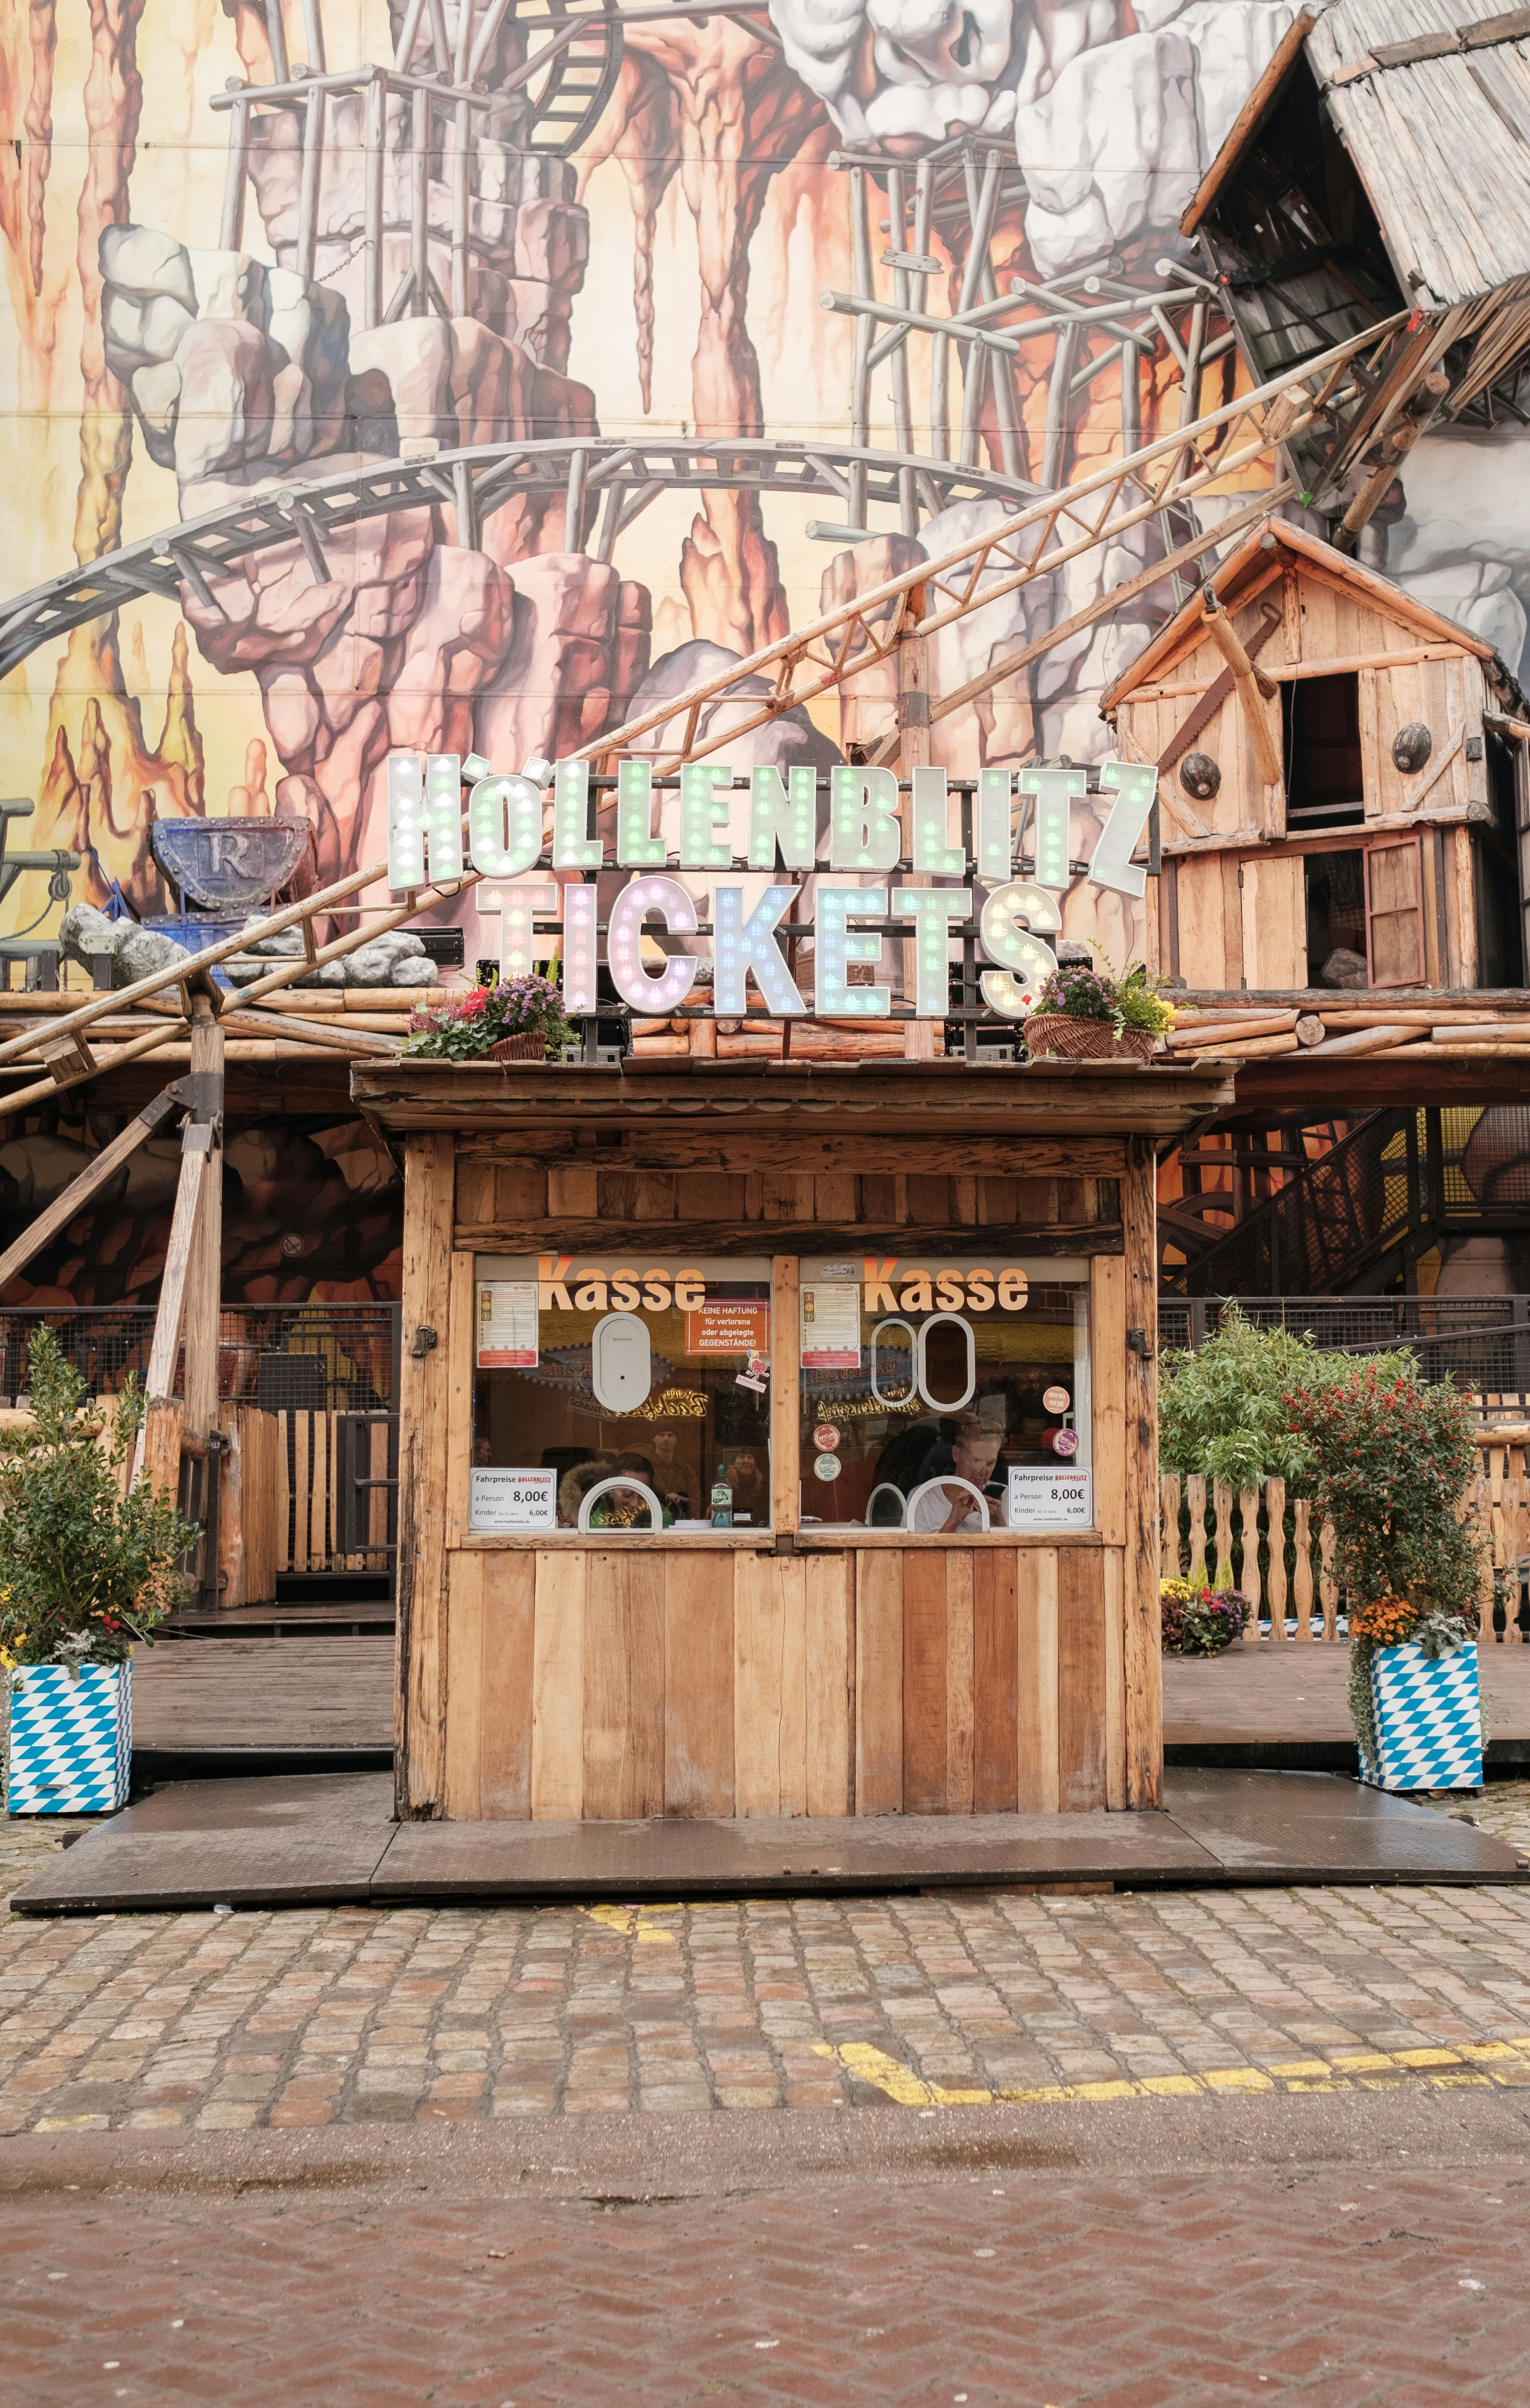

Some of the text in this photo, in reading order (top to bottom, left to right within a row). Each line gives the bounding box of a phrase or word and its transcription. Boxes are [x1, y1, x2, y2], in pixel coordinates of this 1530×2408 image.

[387, 752, 1159, 900] HÖLLENBLITZ
[475, 875, 1062, 1019] TICKETS
[538, 1256, 705, 1311] Kasse
[864, 1258, 1028, 1312] Kasse
[719, 1329, 754, 1337] abgelegte
[699, 1338, 756, 1347] GEGENSTÄNDE!
[476, 1476, 516, 1484] Fahrpreise
[1015, 1474, 1053, 1482] Fahrpreise
[513, 1491, 548, 1503] 8,00€
[1051, 1489, 1085, 1501] 8,00€
